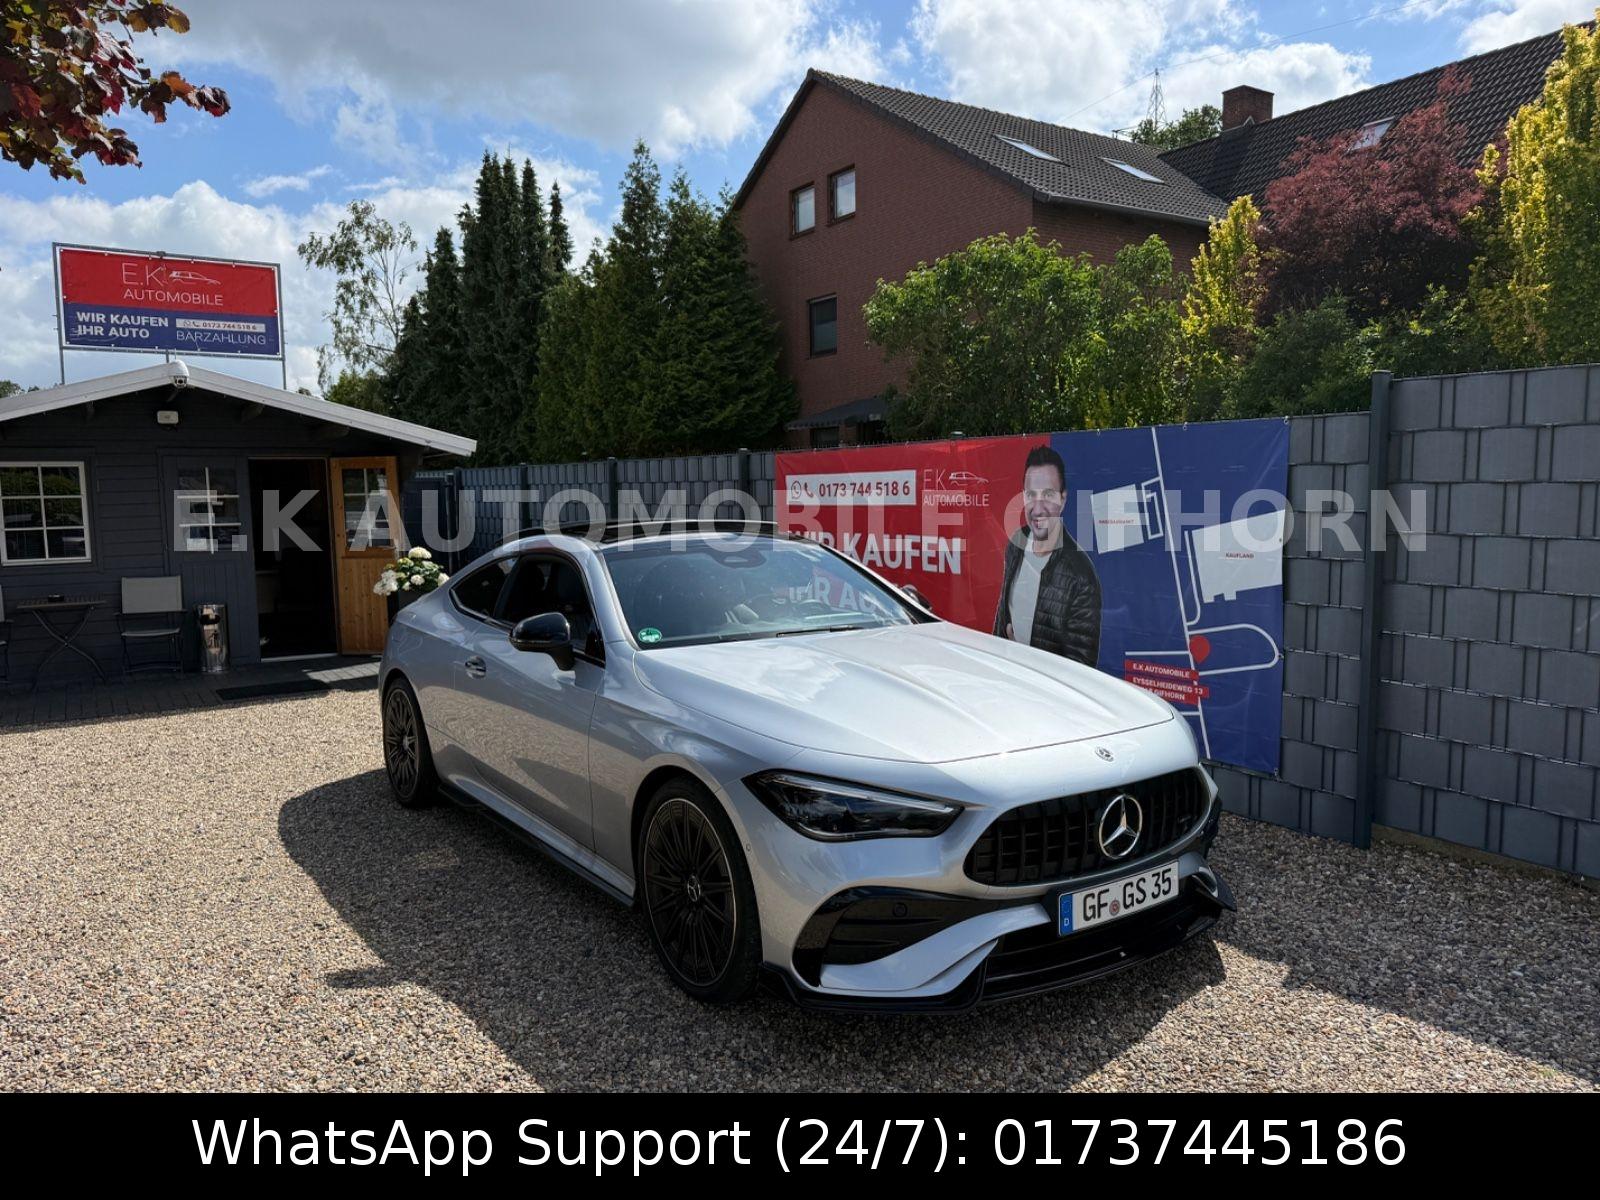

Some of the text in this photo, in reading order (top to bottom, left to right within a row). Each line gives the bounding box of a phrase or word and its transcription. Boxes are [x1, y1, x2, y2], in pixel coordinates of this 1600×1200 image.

[122, 262, 165, 286] E.K
[123, 288, 224, 306] AUTOMOBILE
[76, 311, 169, 327] WIR KAUFEN
[77, 324, 150, 339] IHR AUTO
[176, 330, 266, 345] BARZAHLUNG
[818, 480, 911, 498] 0173 744 518 6
[923, 494, 990, 507] AUTOMOBILE
[843, 532, 962, 575] KAUFEN
[1145, 666, 1190, 679] AUTOMOBILE
[1132, 677, 1193, 693] EYSSELHEIDEWEG
[1194, 687, 1204, 695] 13
[1063, 868, 1172, 927] D GF GS 35
